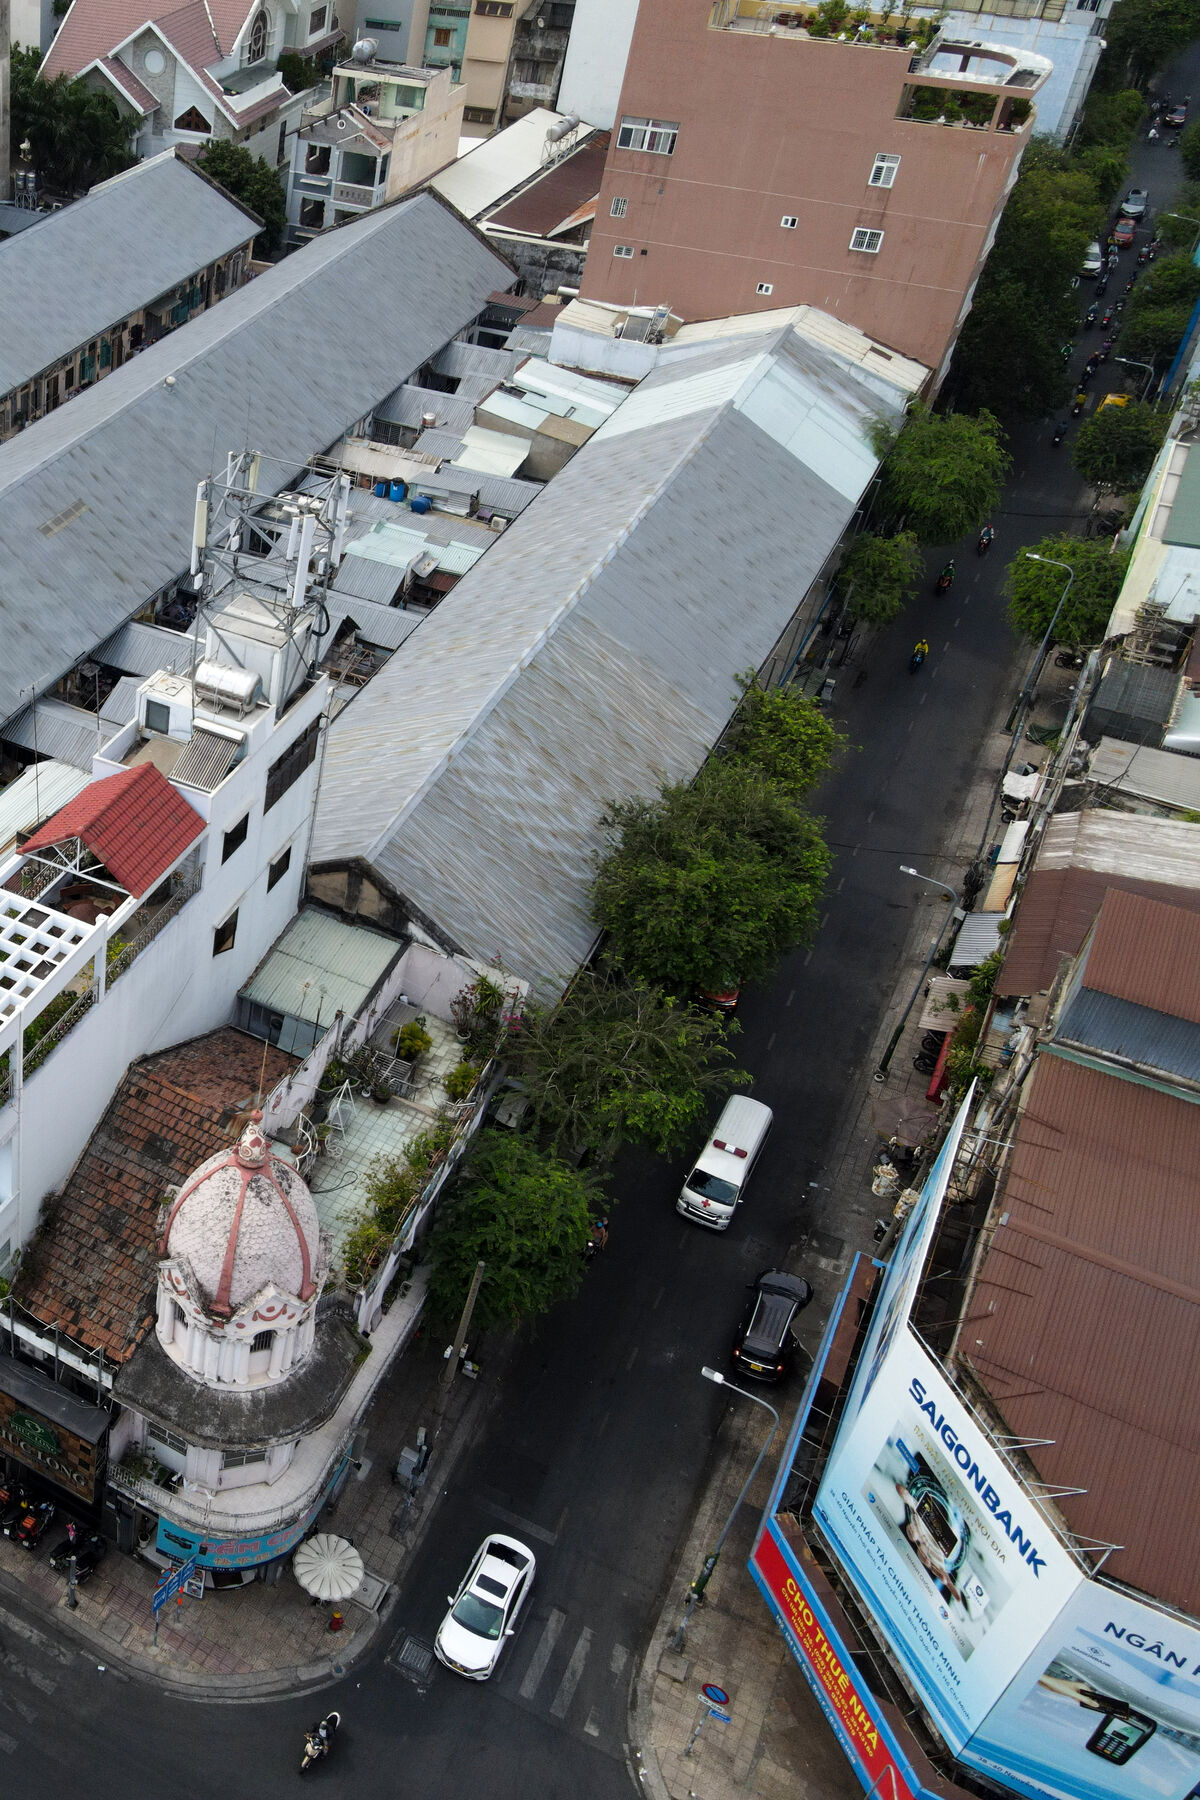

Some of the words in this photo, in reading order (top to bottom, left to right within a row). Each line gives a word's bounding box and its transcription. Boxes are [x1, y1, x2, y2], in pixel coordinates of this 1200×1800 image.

[36, 1450, 86, 1488] LONG
[908, 1377, 1048, 1579] SAIGONBANK
[786, 1578, 813, 1626] CHO
[815, 1627, 850, 1693] THUÊ
[849, 1695, 878, 1750] NHÀ
[841, 1488, 857, 1516] GIẢI
[856, 1512, 876, 1547] PHÁP
[875, 1543, 888, 1566] TÀI
[887, 1563, 912, 1606] CHÍNH
[911, 1603, 940, 1651] THÔNG
[938, 1650, 960, 1687] MINH
[1103, 1621, 1188, 1669] NGÂN
